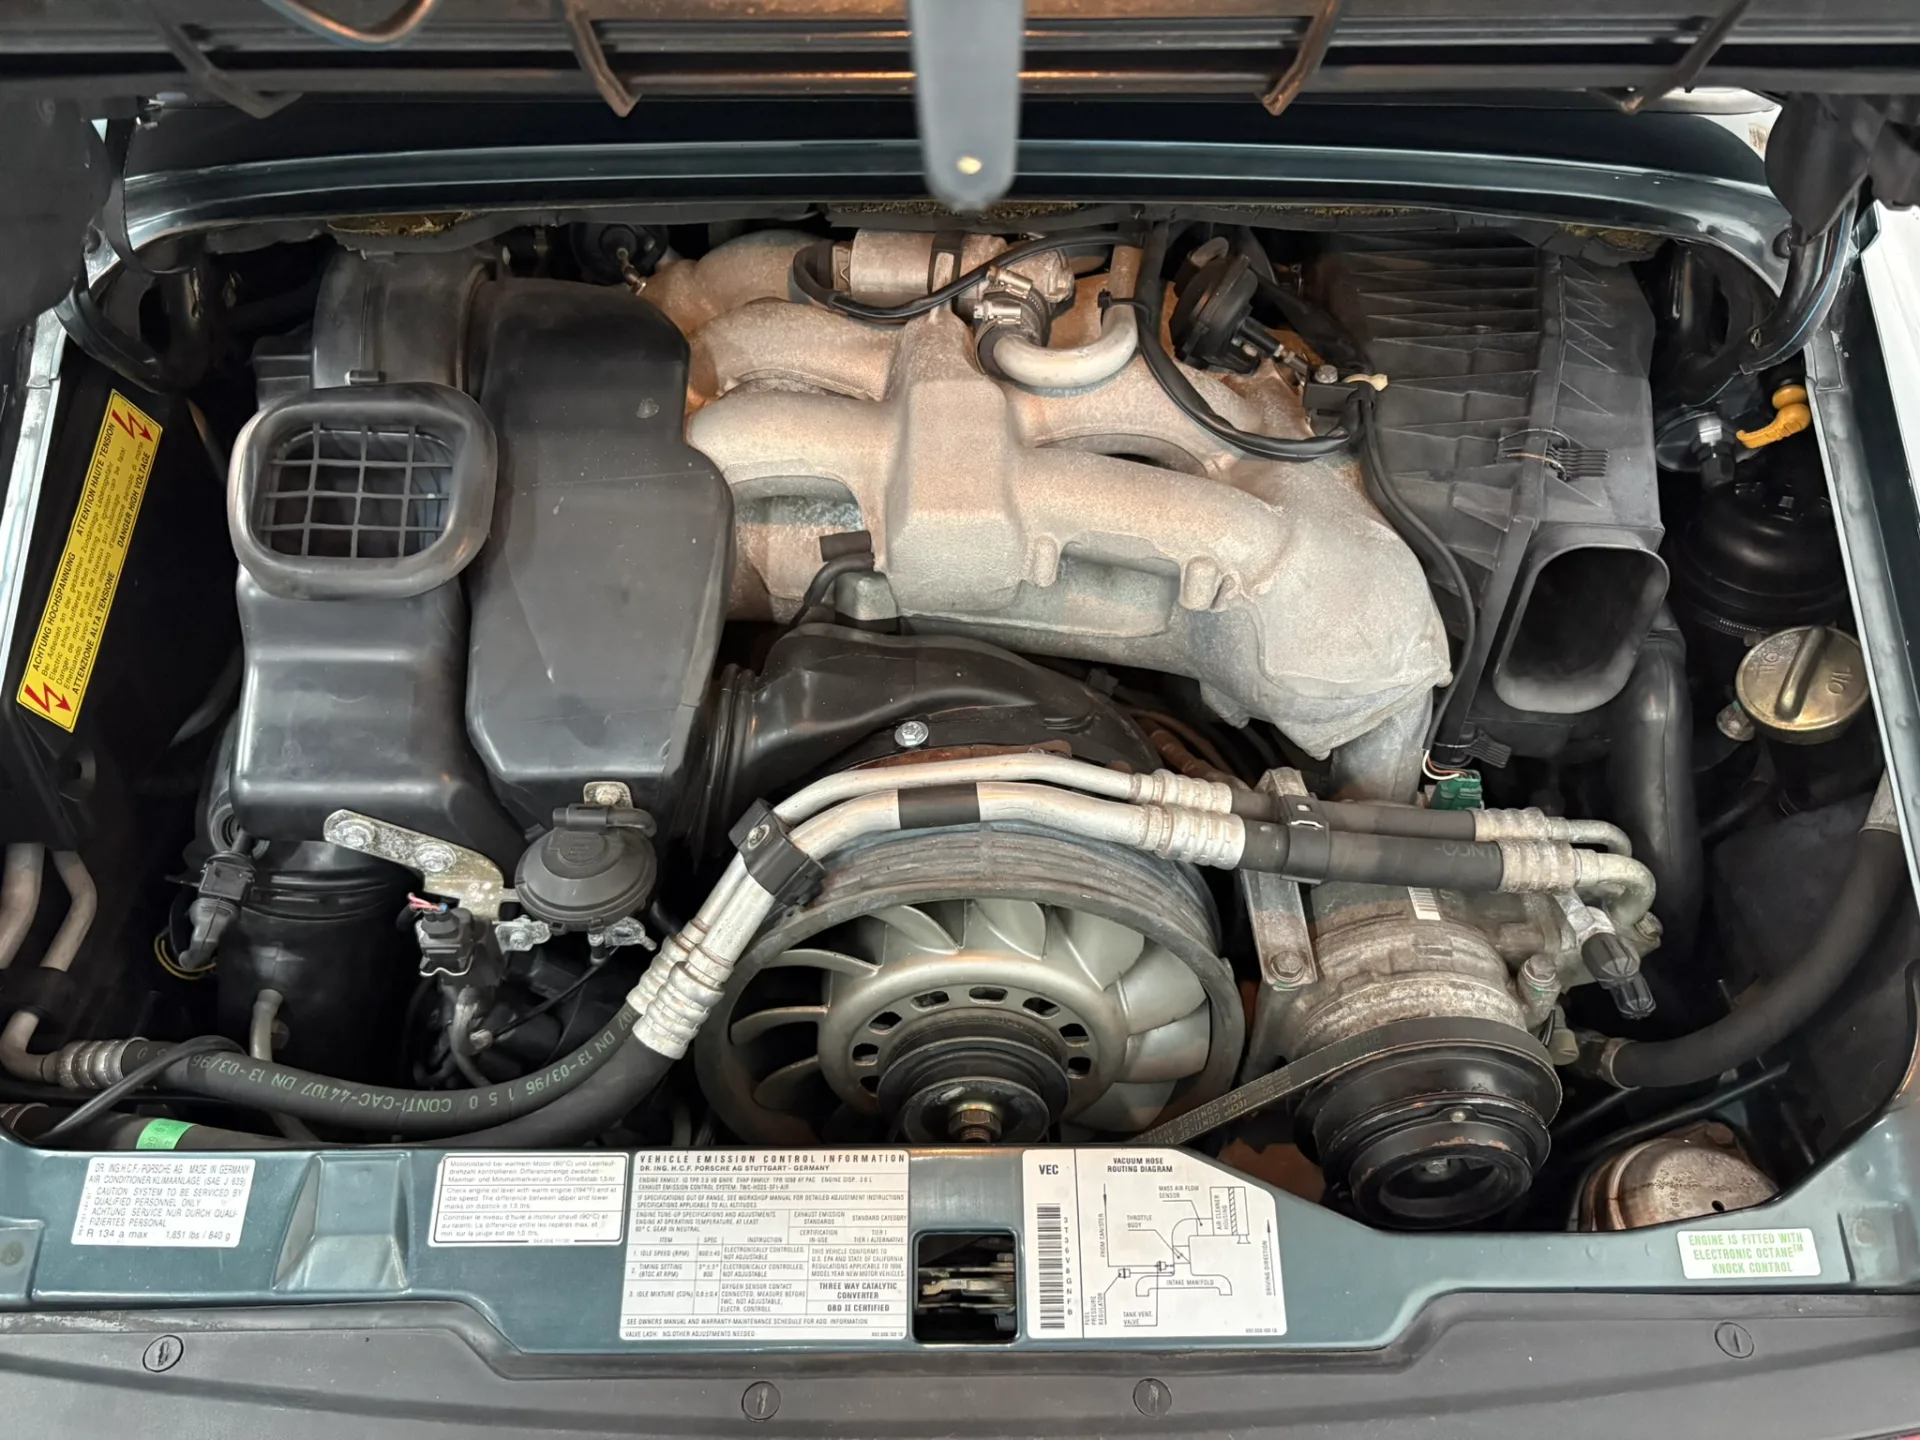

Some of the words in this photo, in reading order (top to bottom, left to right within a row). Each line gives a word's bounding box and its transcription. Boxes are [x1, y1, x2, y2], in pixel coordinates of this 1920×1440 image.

[116, 445, 126, 463] fatal
[112, 464, 120, 476] be
[75, 486, 96, 536] ATTENTION
[90, 457, 105, 489] HAUTE
[99, 421, 116, 459] TENSION
[109, 477, 117, 491] can
[99, 492, 113, 521] ignition
[116, 510, 132, 548] DANGER
[127, 488, 139, 512] HIGH
[134, 451, 150, 490] VOLTAGE
[96, 522, 103, 533] on
[85, 534, 100, 565] working
[68, 555, 85, 594] gesamten
[78, 565, 89, 588] when
[62, 594, 71, 609] der
[67, 589, 82, 622] suffered
[31, 625, 52, 672] ACHTUNG
[46, 550, 75, 626] HOCHSPANNUNG
[56, 656, 71, 687] Danger
[66, 641, 74, 654] de
[71, 620, 81, 639] mort
[78, 606, 85, 618] en
[87, 575, 95, 588] de
[92, 546, 104, 574] travaux
[59, 611, 66, 623] an
[59, 624, 71, 648] shock
[71, 638, 94, 695] ATTENZIONE
[89, 613, 101, 638] ALTA
[96, 570, 114, 613] TENSIONE
[46, 625, 62, 660] Arbeiten
[41, 661, 51, 677] Bei
[49, 650, 63, 682] Electric
[595, 1030, 616, 1053] DN
[271, 1072, 298, 1090] DN
[469, 1096, 478, 1109] 0
[489, 1092, 498, 1106] 5
[639, 1155, 688, 1163] VEHICLE
[823, 1154, 904, 1162] INFORMATION
[140, 1163, 171, 1173] PORSCHE
[173, 1164, 183, 1174] AG
[188, 1164, 207, 1174] MADE
[209, 1165, 217, 1174] IN
[218, 1165, 249, 1175] GERMANY
[1039, 1164, 1058, 1174] VEC
[88, 1174, 101, 1183] AIR
[95, 1186, 128, 1196] CAUTION
[133, 1187, 163, 1196] SYSTEM
[166, 1187, 177, 1197] TO
[179, 1188, 191, 1197] BE
[192, 1188, 229, 1197] SERVICED
[231, 1189, 243, 1198] BY
[93, 1197, 131, 1206] QUALIFIED
[134, 1197, 177, 1206] PERSONNEL
[181, 1198, 201, 1207] ONLY
[91, 1207, 126, 1216] ACHTUNG
[131, 1208, 163, 1216] SERVICE
[165, 1208, 182, 1217] NUR
[184, 1209, 211, 1217] DURCH
[88, 1217, 126, 1226] FIZIERTES
[128, 1218, 167, 1227] PERSONAL
[97, 1229, 115, 1237] 134
[188, 1231, 200, 1239] lbs
[1688, 1234, 1724, 1245] ENGINE
[1727, 1234, 1738, 1244] IS
[1741, 1233, 1775, 1244] FITTED
[1778, 1232, 1803, 1243] WITH
[1692, 1248, 1752, 1260] ELECTRONIC
[1711, 1262, 1744, 1273] KNOCK
[1748, 1261, 1793, 1272] CONTROL
